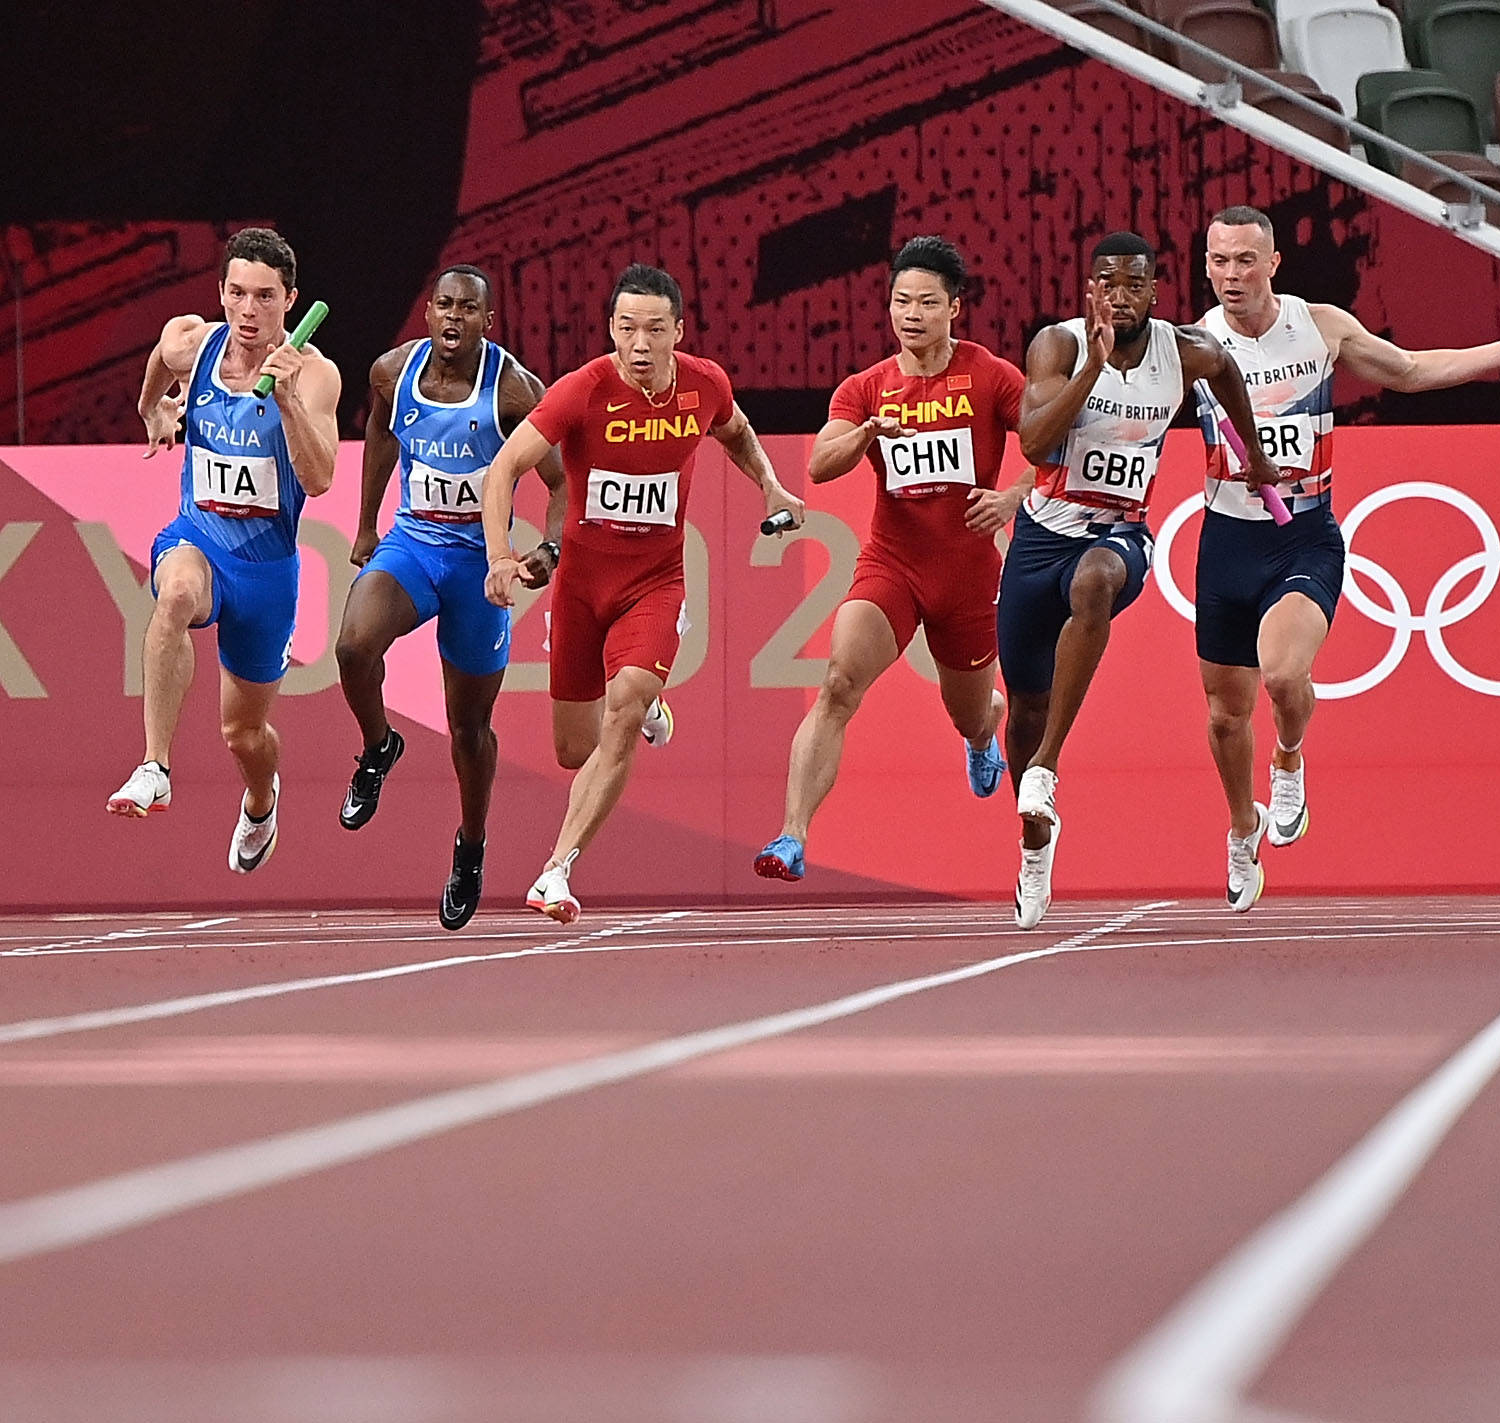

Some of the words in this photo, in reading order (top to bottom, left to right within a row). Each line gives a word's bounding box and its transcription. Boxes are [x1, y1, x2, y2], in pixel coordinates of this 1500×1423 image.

[1264, 360, 1317, 385] BRITAIN
[879, 394, 974, 425] CHINA
[1087, 396, 1122, 417] GREAT
[1125, 405, 1170, 420] BRITAIN
[200, 419, 261, 448] ITALIA
[605, 414, 700, 442] CHINA
[1258, 424, 1302, 459] BR
[410, 438, 474, 458] ITALIA
[891, 438, 960, 476] CHN
[207, 459, 257, 496] ITA
[1082, 450, 1145, 488] GBR
[425, 474, 478, 506] ITA
[600, 480, 667, 514] CHN
